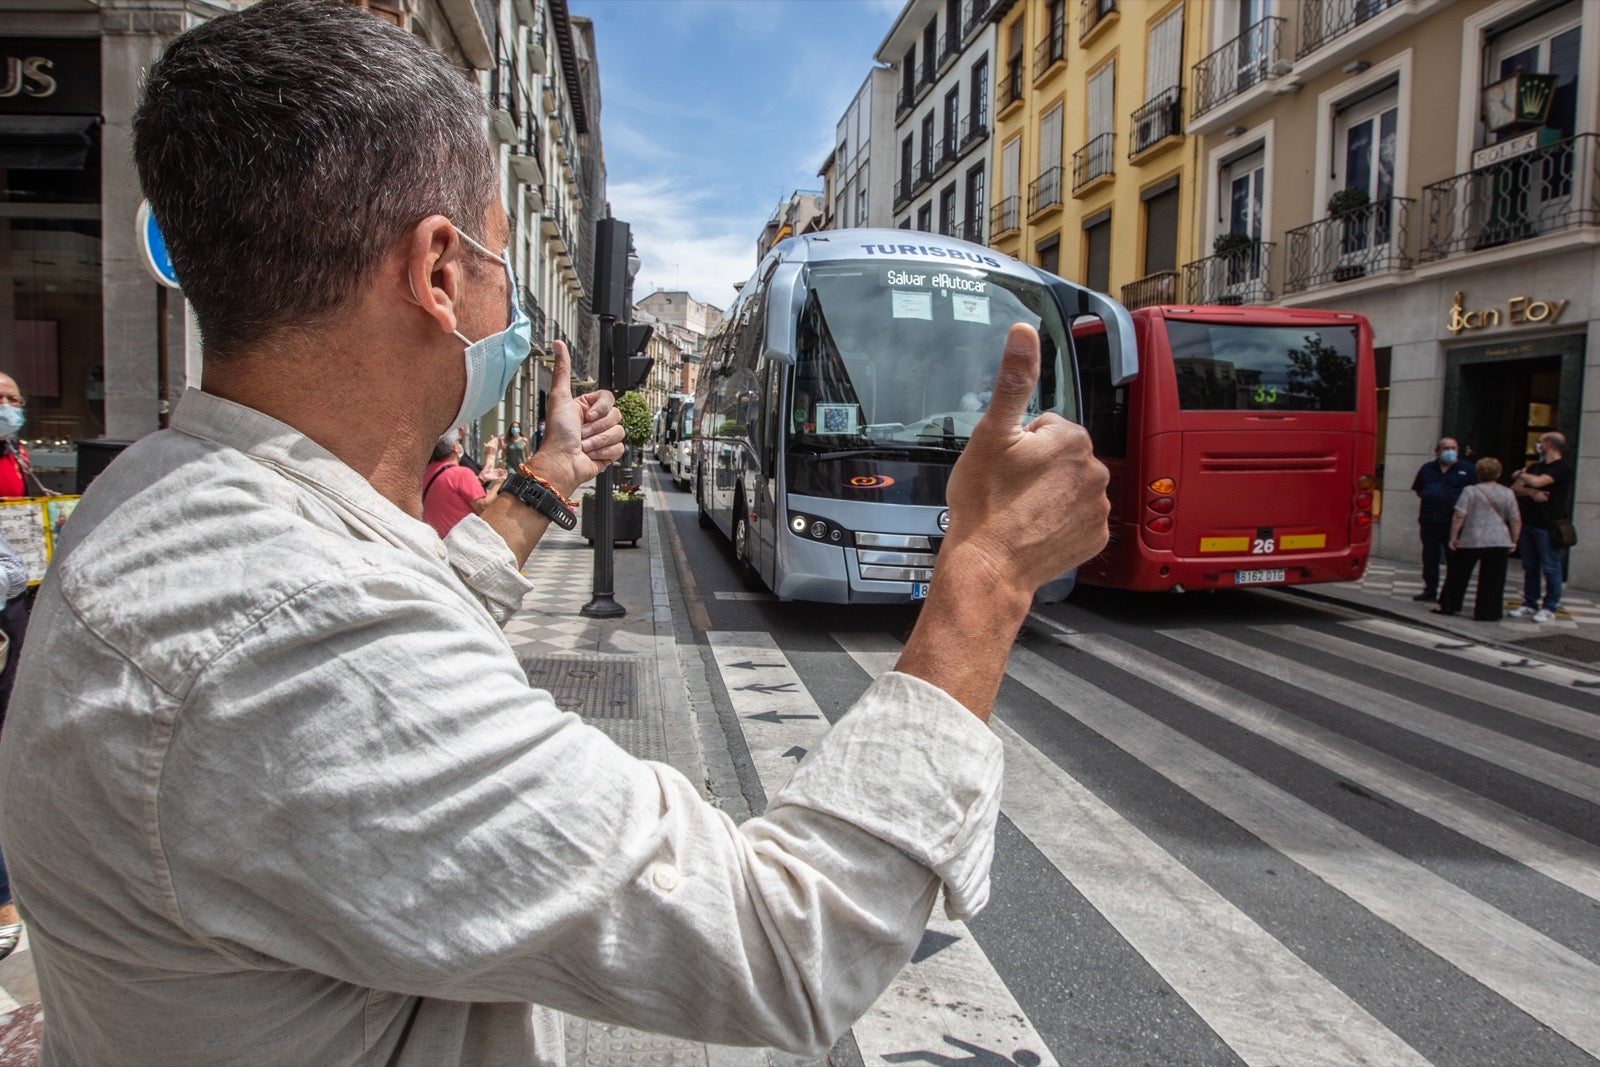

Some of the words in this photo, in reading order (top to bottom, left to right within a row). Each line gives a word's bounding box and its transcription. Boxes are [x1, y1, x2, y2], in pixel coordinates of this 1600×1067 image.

[1476, 135, 1534, 165] ROLEX
[861, 244, 1001, 268] TURISBUS
[887, 270, 927, 286] Salvar
[1447, 291, 1500, 335] San
[1508, 296, 1568, 324] Eloy
[1252, 539, 1275, 553] 26
[1240, 571, 1264, 581] 8162
